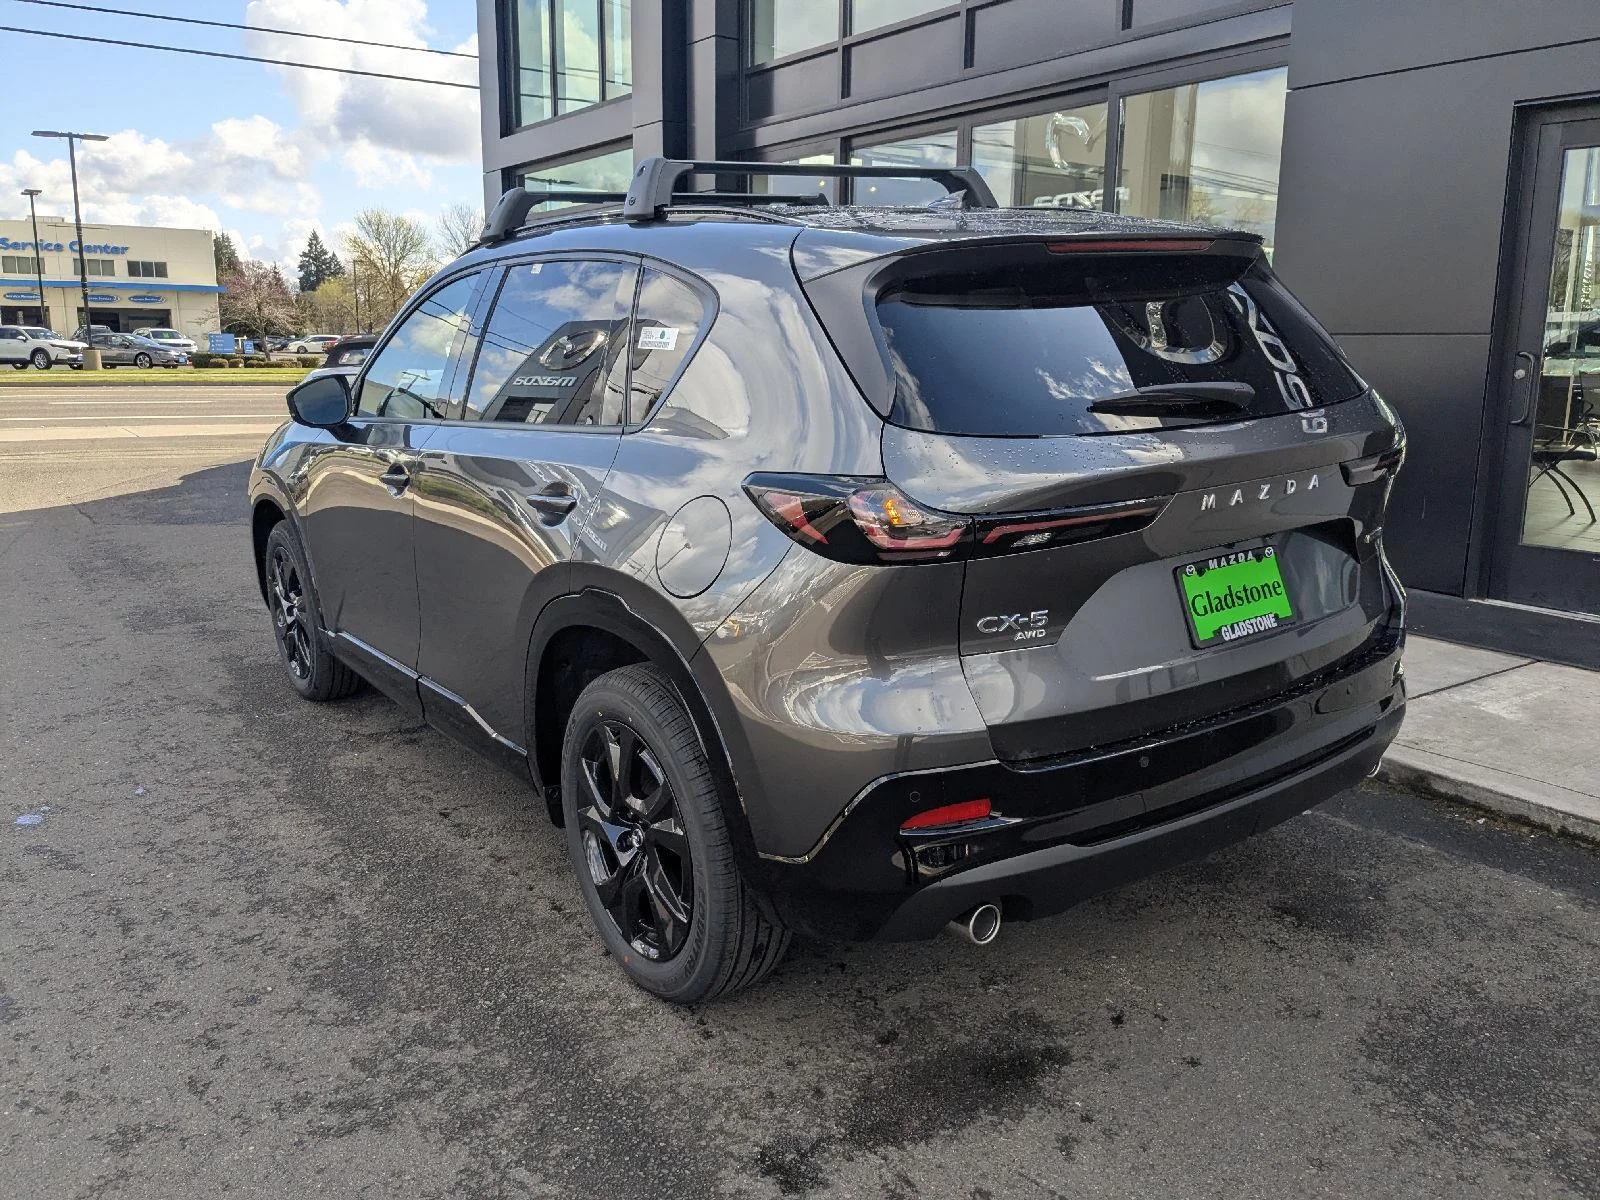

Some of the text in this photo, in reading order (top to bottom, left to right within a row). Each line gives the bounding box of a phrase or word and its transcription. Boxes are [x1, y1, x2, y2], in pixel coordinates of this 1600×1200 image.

[69, 241, 130, 254] Center
[1200, 474, 1319, 511] MAZDA
[1208, 550, 1254, 570] MAZDA
[1190, 580, 1283, 617] Gladstone
[977, 609, 1049, 633] CX-5
[1221, 613, 1278, 642] GLADSTONE
[1014, 629, 1047, 642] AWD
